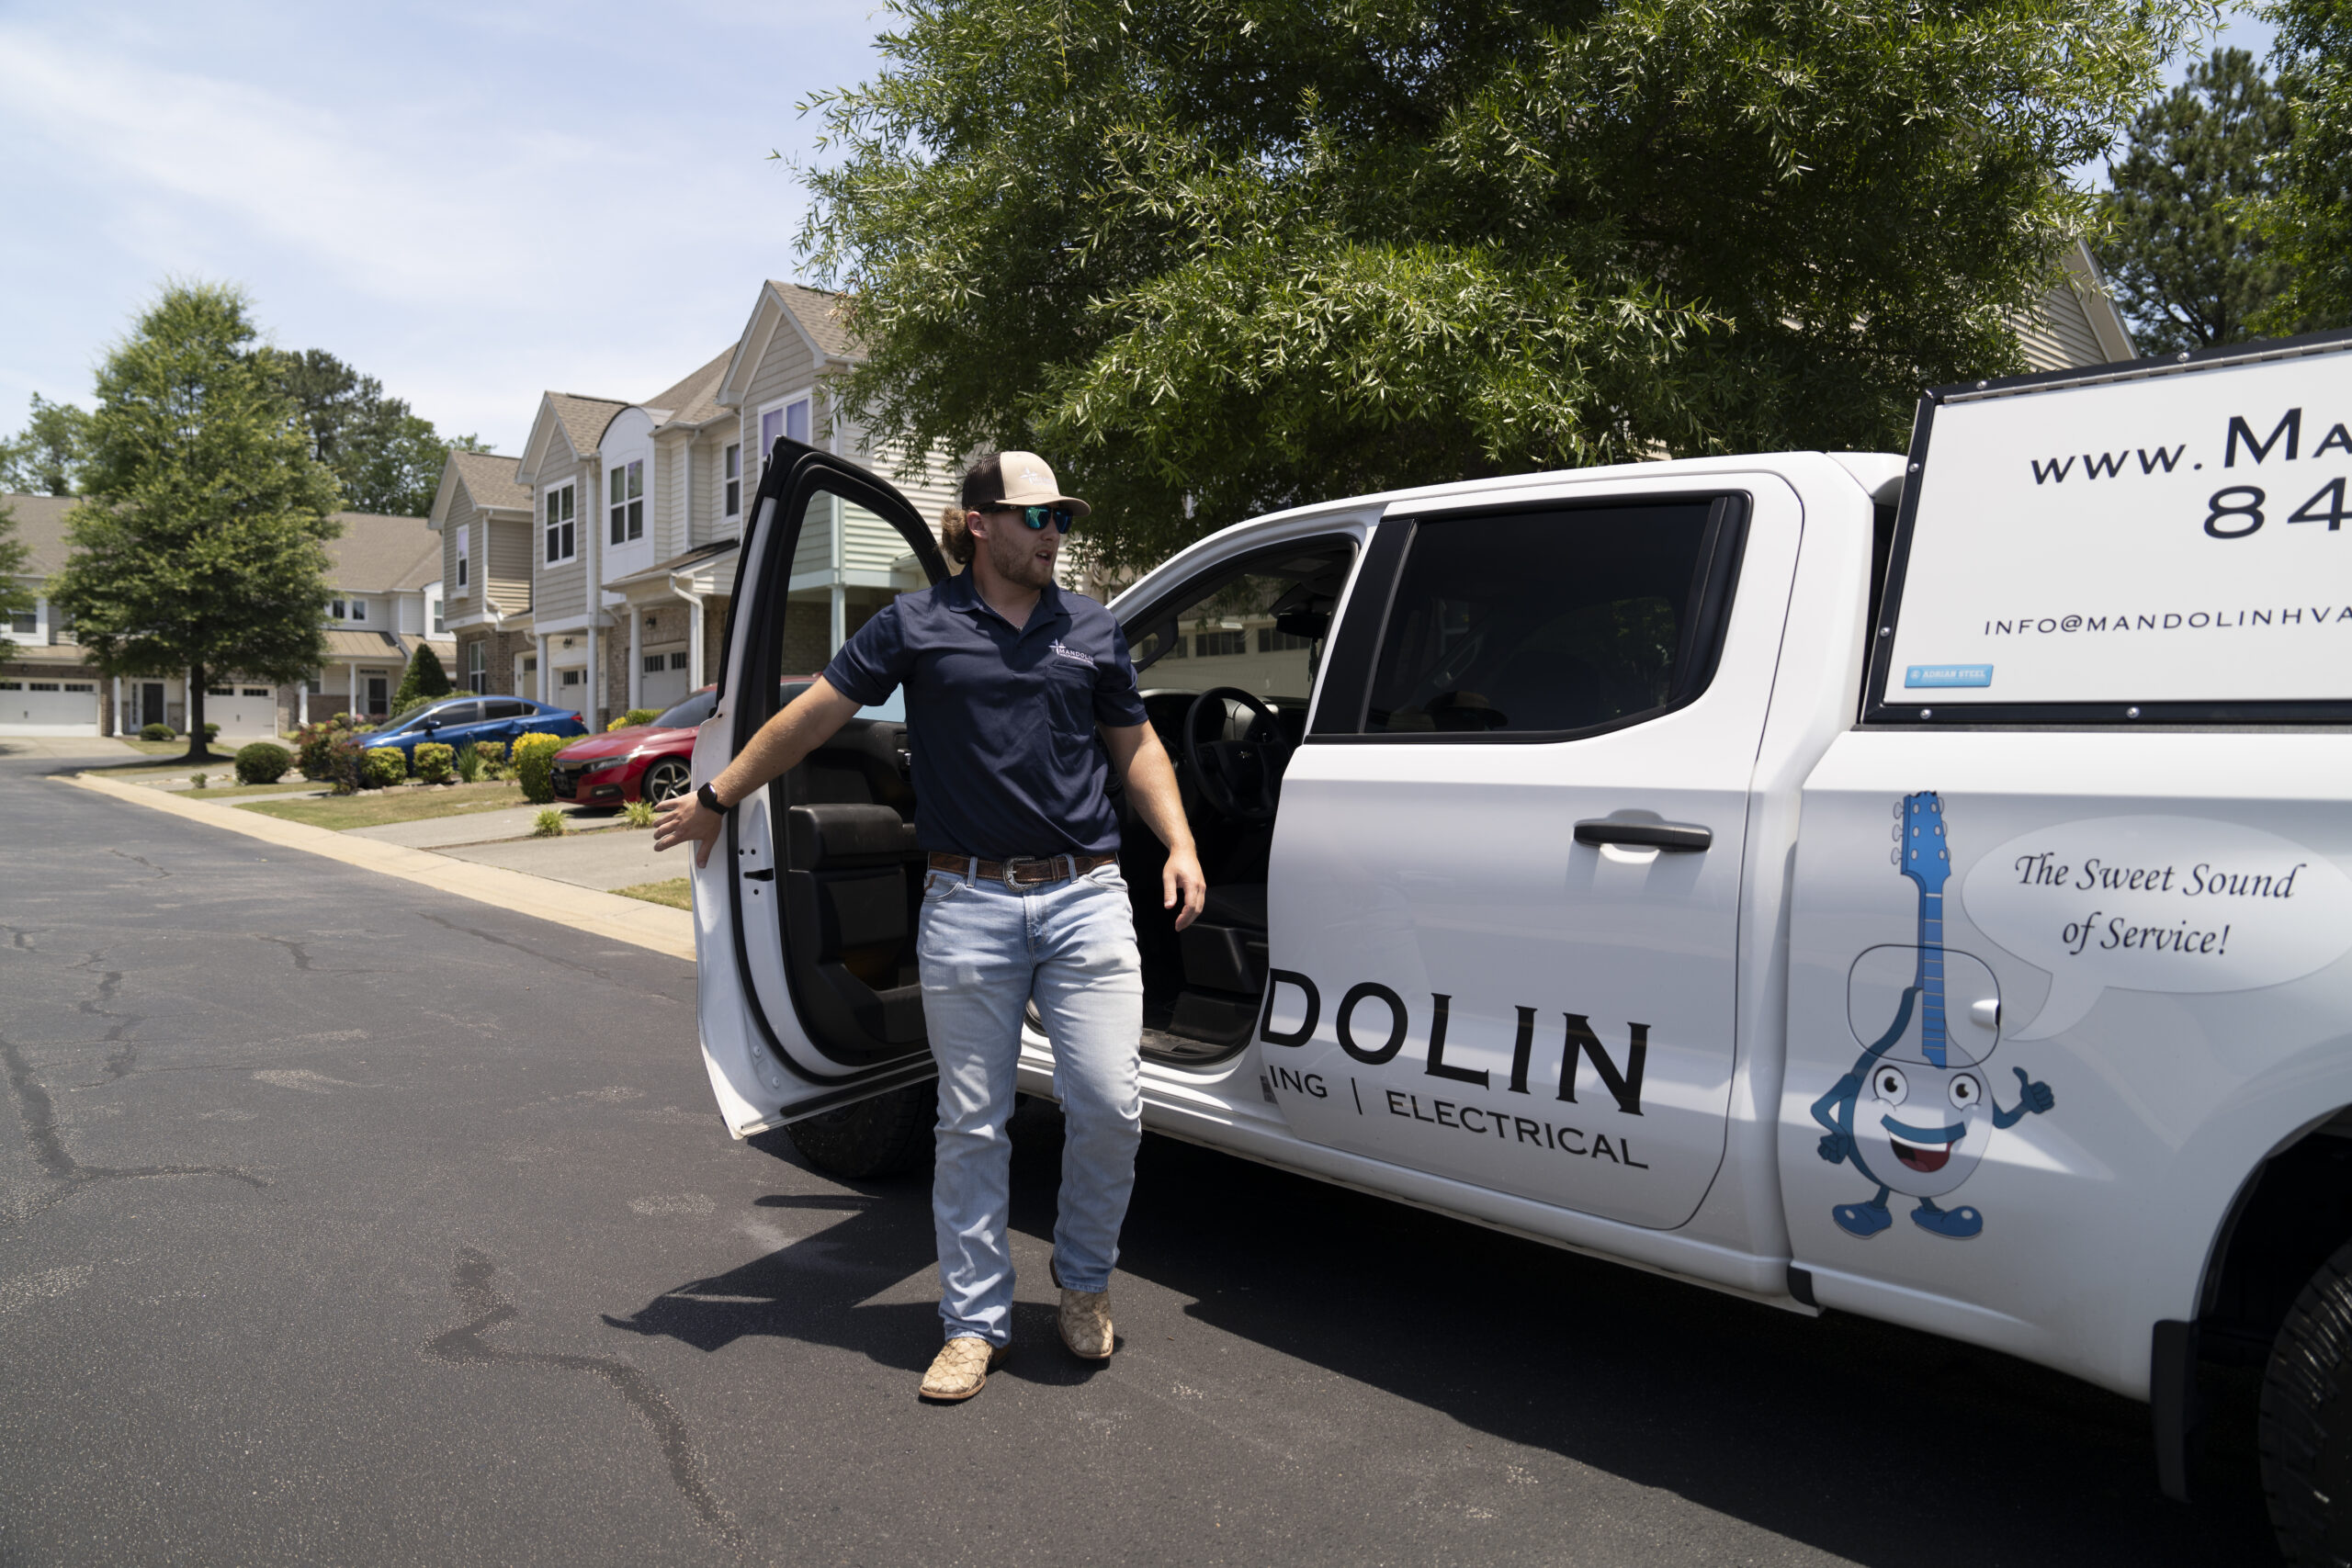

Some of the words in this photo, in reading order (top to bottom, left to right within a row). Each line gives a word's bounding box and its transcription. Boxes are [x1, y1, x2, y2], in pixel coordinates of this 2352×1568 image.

[2203, 477, 2352, 540] 84
[1984, 606, 2352, 636] INFO@MANDOLINHVA
[1922, 669, 1957, 678] ADRIAN
[1958, 668, 1986, 677] STEEL
[2015, 852, 2069, 886] The
[2075, 858, 2175, 891] Sweet
[2182, 863, 2307, 898] Sound
[2062, 911, 2102, 955] of
[2099, 917, 2231, 955] Service!
[1260, 967, 1651, 1116] DOLIN
[1269, 1065, 1329, 1099] ING
[1385, 1089, 1649, 1169] ELECTRICAL
